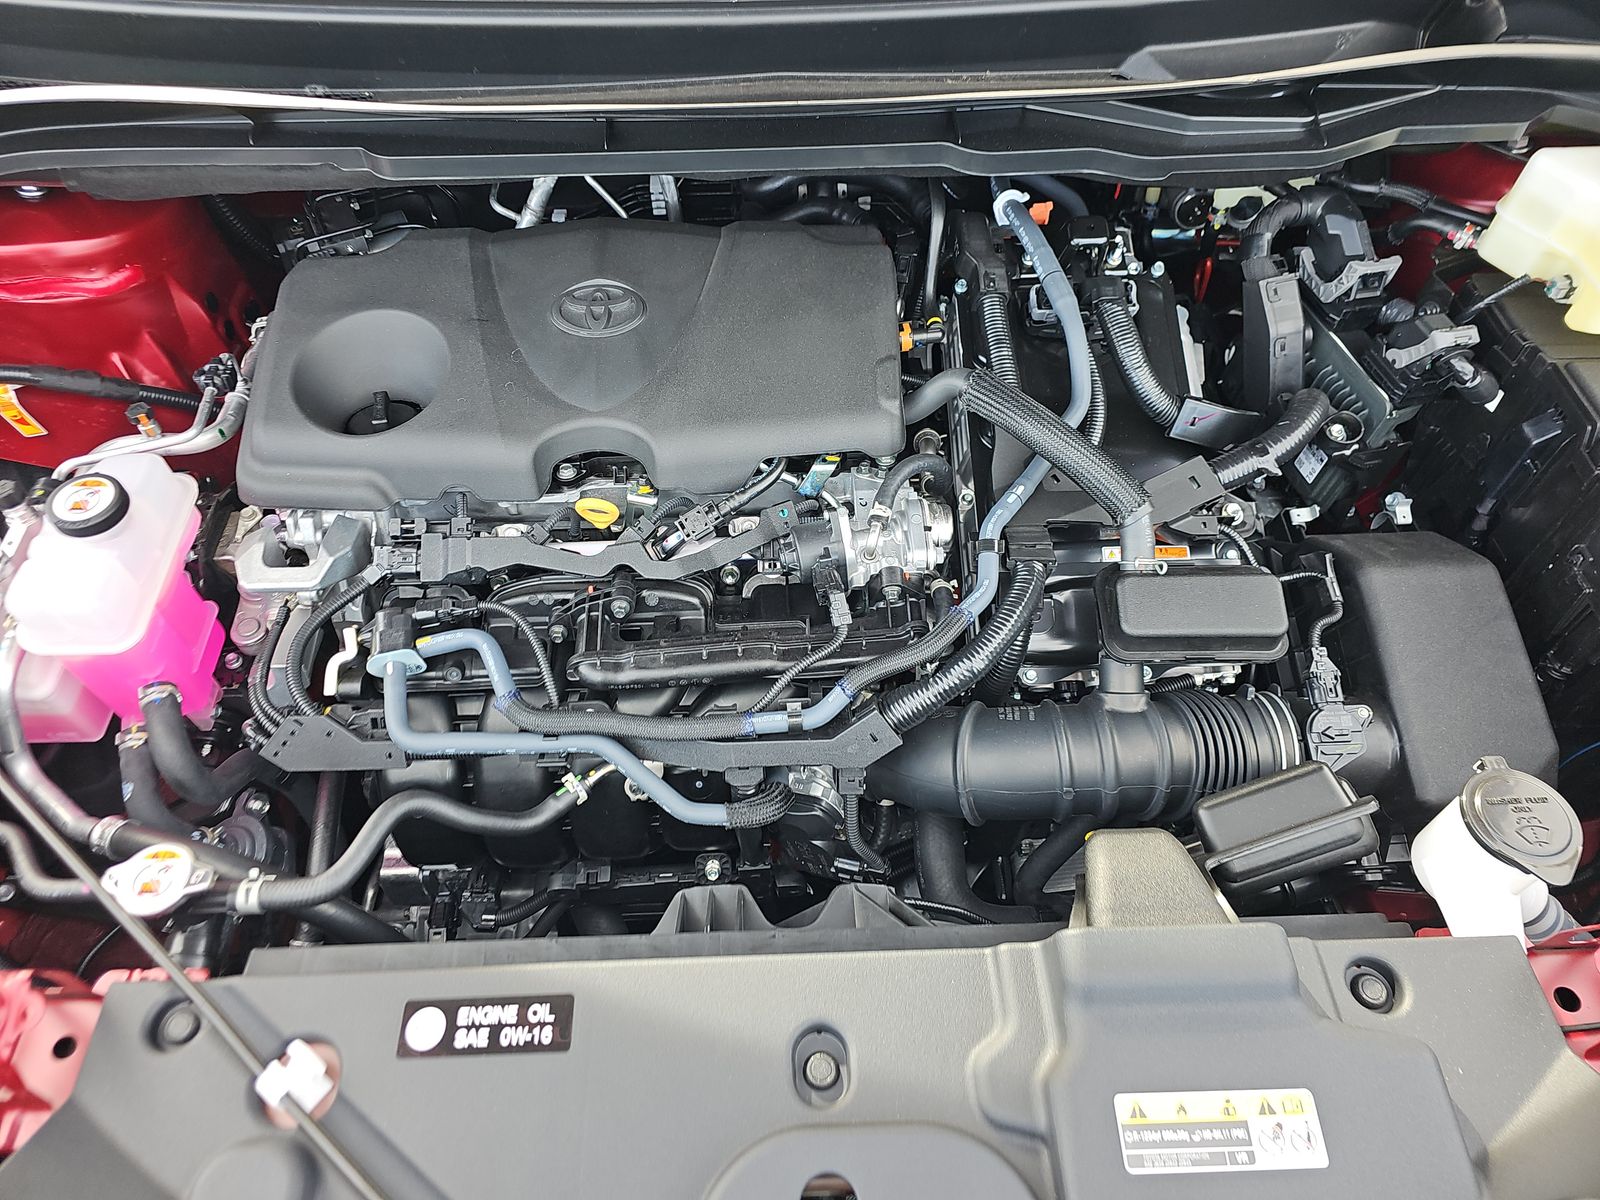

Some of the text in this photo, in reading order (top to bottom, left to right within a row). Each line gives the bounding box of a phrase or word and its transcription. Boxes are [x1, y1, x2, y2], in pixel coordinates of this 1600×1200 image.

[1524, 796, 1549, 804] FLUID
[456, 1003, 556, 1026] ENGINE OIL
[453, 1025, 553, 1049] SAE 0W-16
